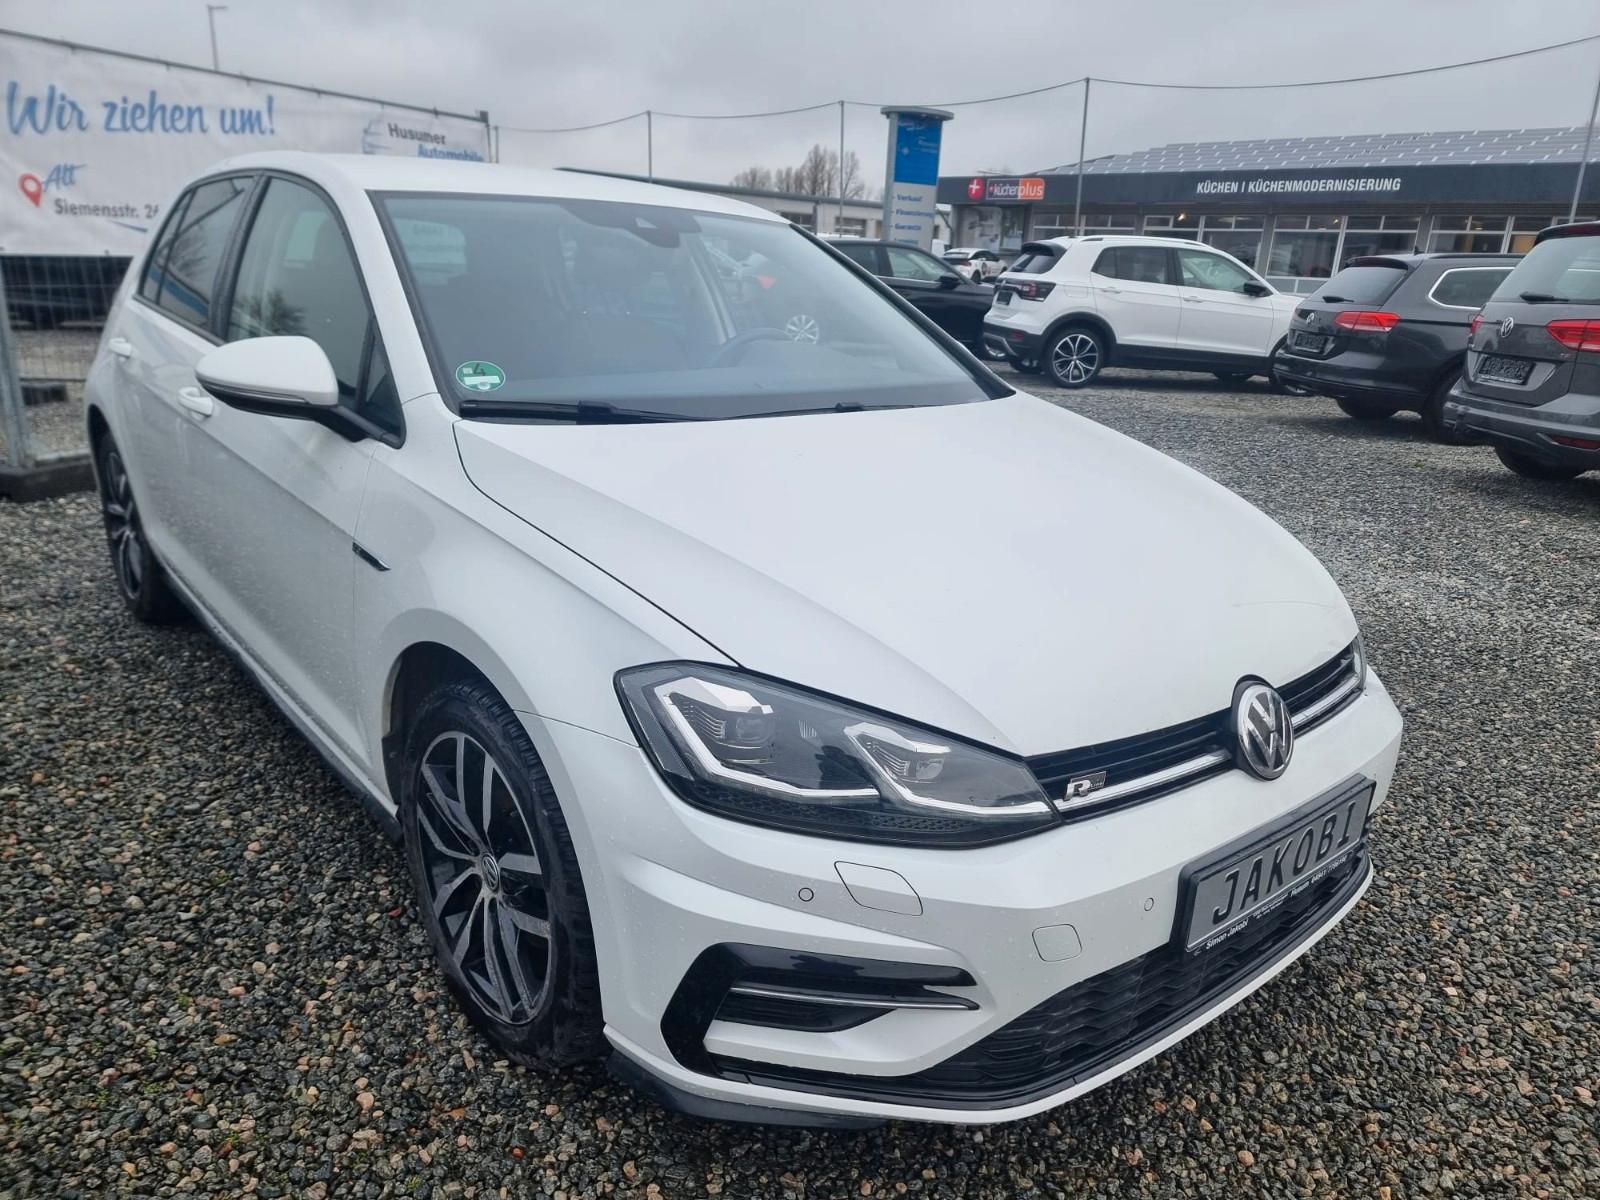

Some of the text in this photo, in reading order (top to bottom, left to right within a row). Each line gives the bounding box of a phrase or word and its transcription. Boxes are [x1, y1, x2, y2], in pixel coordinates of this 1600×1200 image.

[6, 80, 276, 135] Wir ziehen um!
[387, 122, 447, 145] Husumer
[43, 163, 87, 192] Alt
[1196, 179, 1239, 194] KÜCHEN
[1248, 177, 1402, 193] KÜCHENMODERNISIERUNG
[54, 197, 139, 218] Siemensstr.
[473, 362, 486, 376] 4
[1212, 800, 1357, 925] JAKOBI
[1205, 932, 1228, 950] Simon
